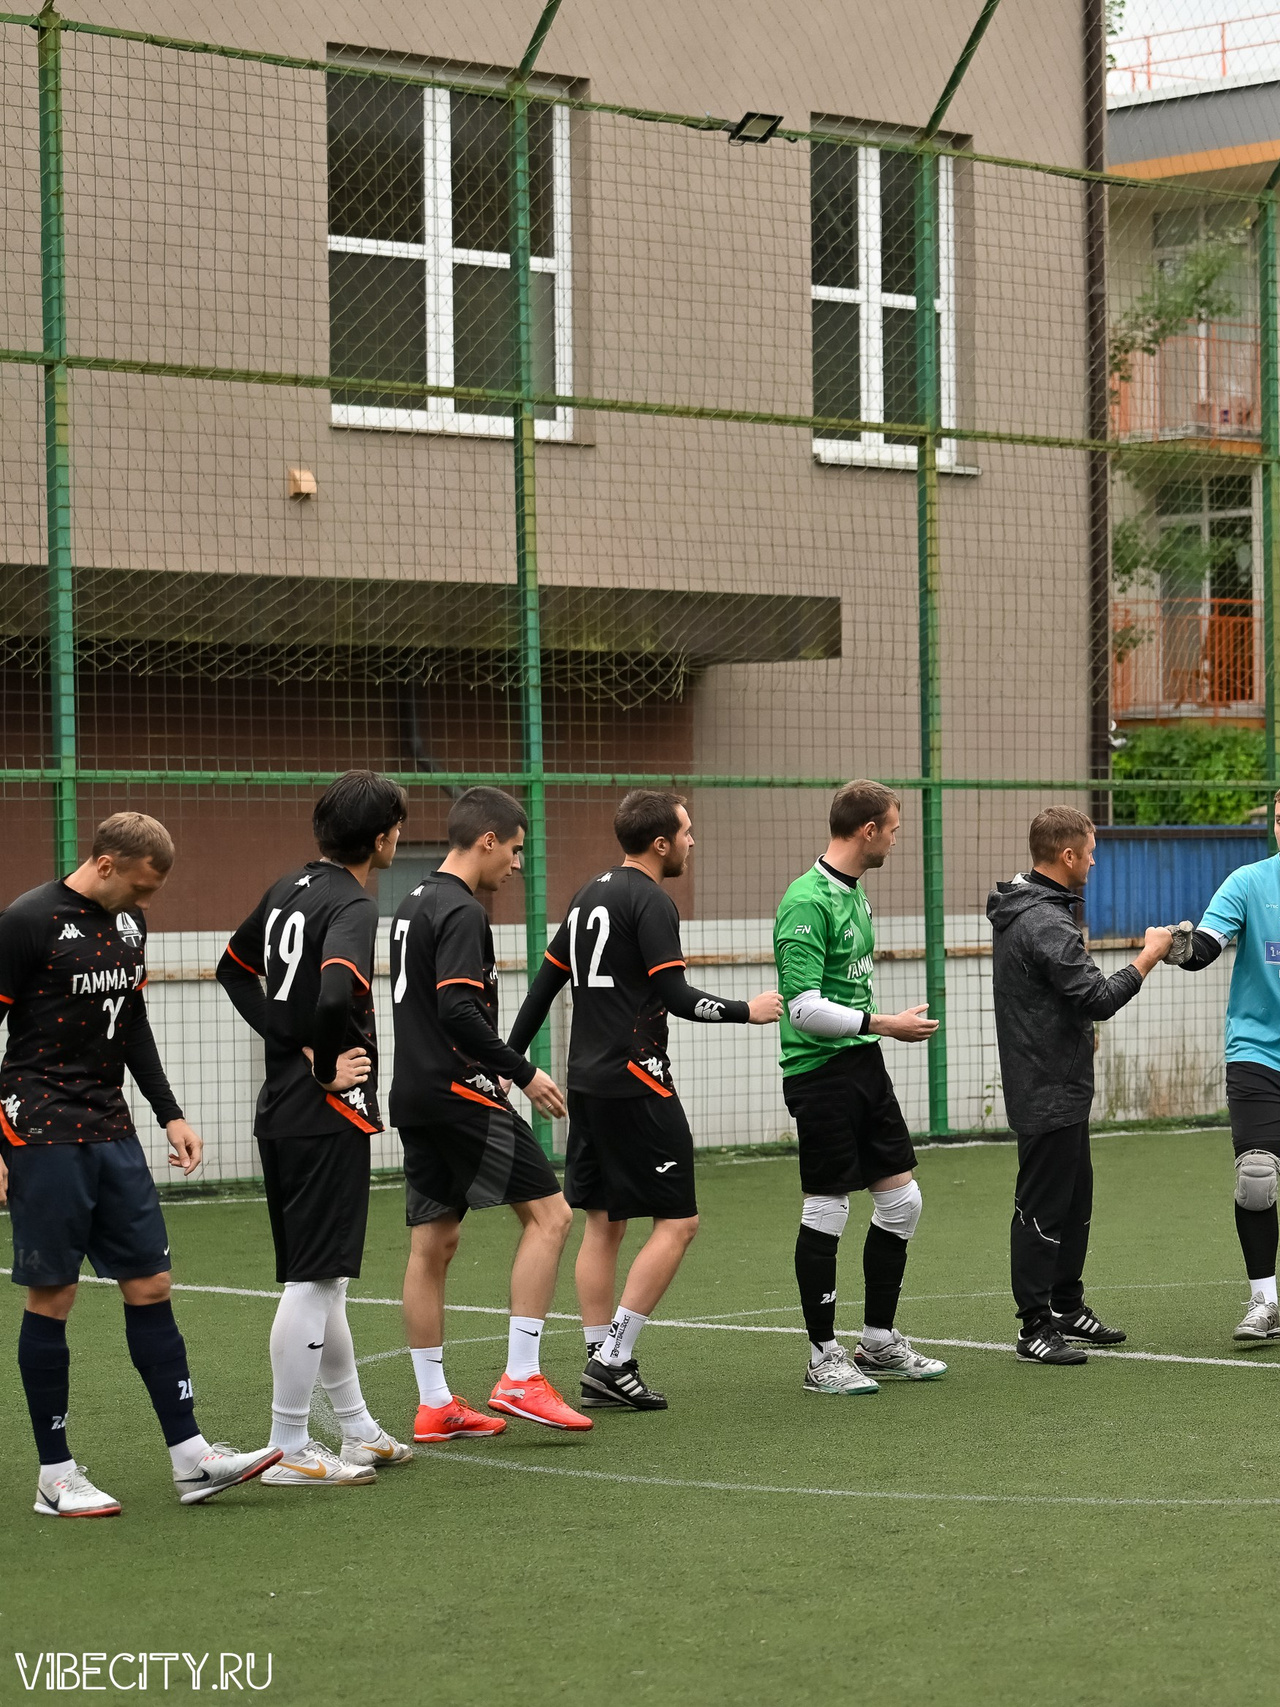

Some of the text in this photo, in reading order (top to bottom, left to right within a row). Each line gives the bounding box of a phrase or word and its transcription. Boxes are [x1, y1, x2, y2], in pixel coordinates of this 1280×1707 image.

[394, 918, 411, 1004] 7
[567, 905, 615, 988] 12
[795, 925, 811, 934] FN
